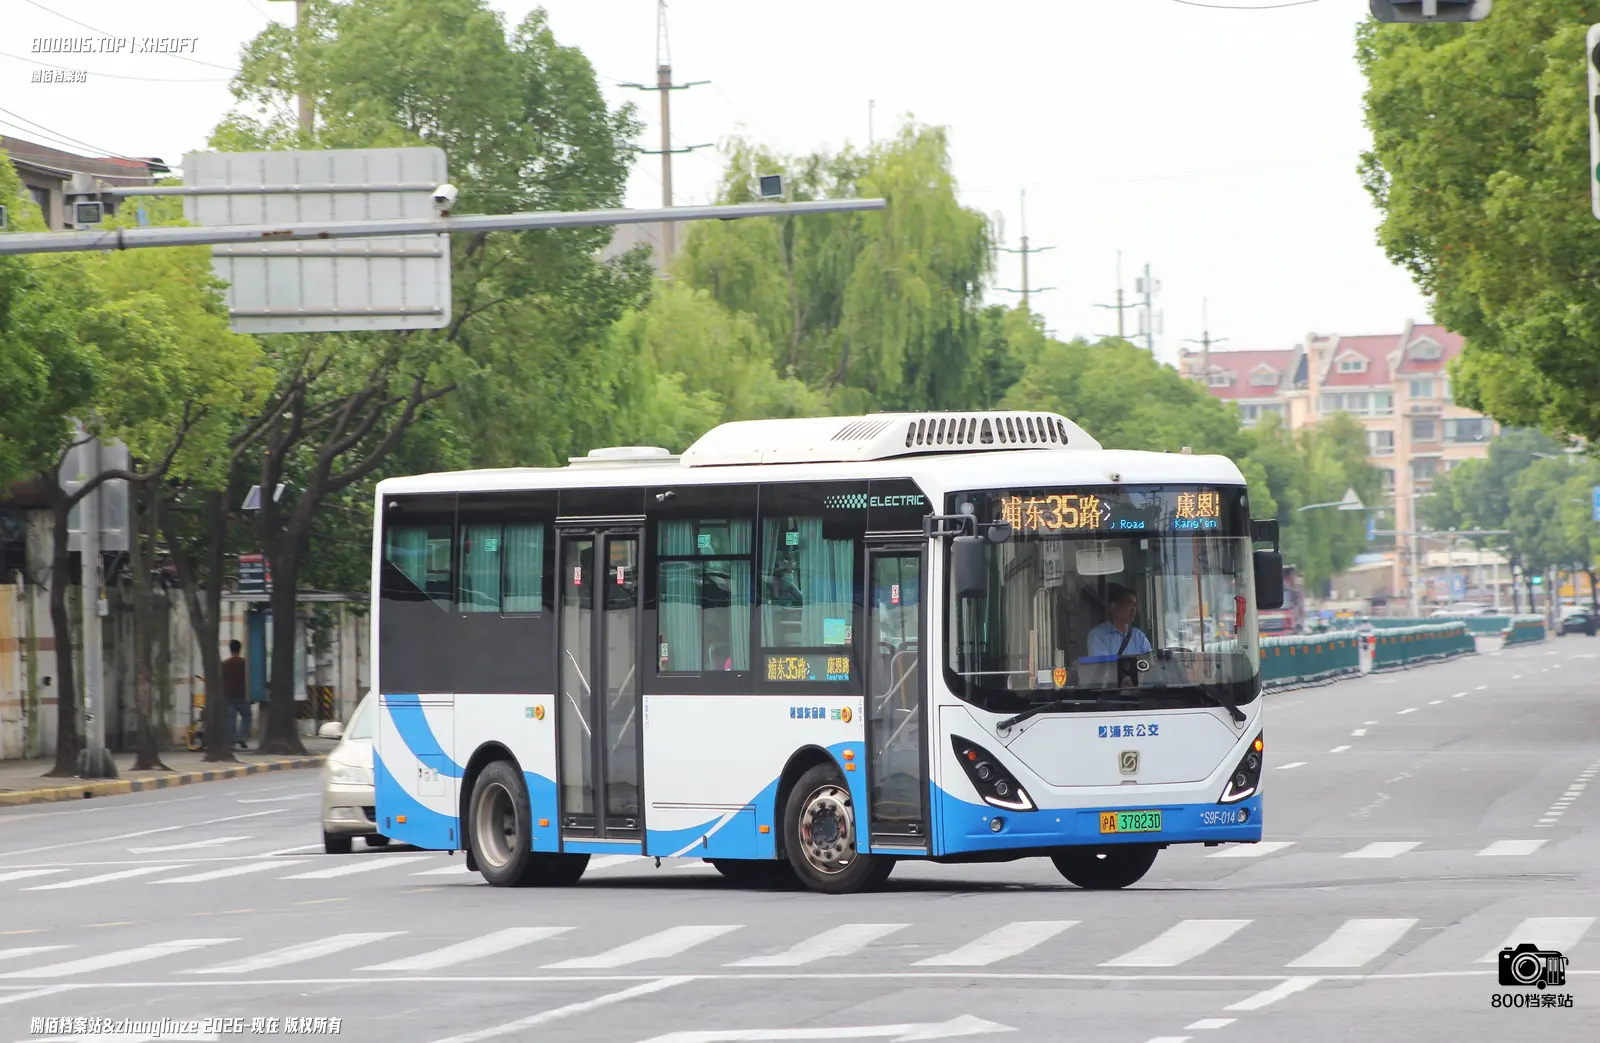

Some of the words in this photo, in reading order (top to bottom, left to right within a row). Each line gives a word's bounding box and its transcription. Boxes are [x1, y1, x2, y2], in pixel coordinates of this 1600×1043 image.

[869, 495, 925, 507] ELECTRIC
[1001, 494, 1101, 531] 浦东35路
[1120, 519, 1145, 529] Road
[1109, 723, 1159, 738] 浦东公交
[1120, 813, 1161, 830] 37823D
